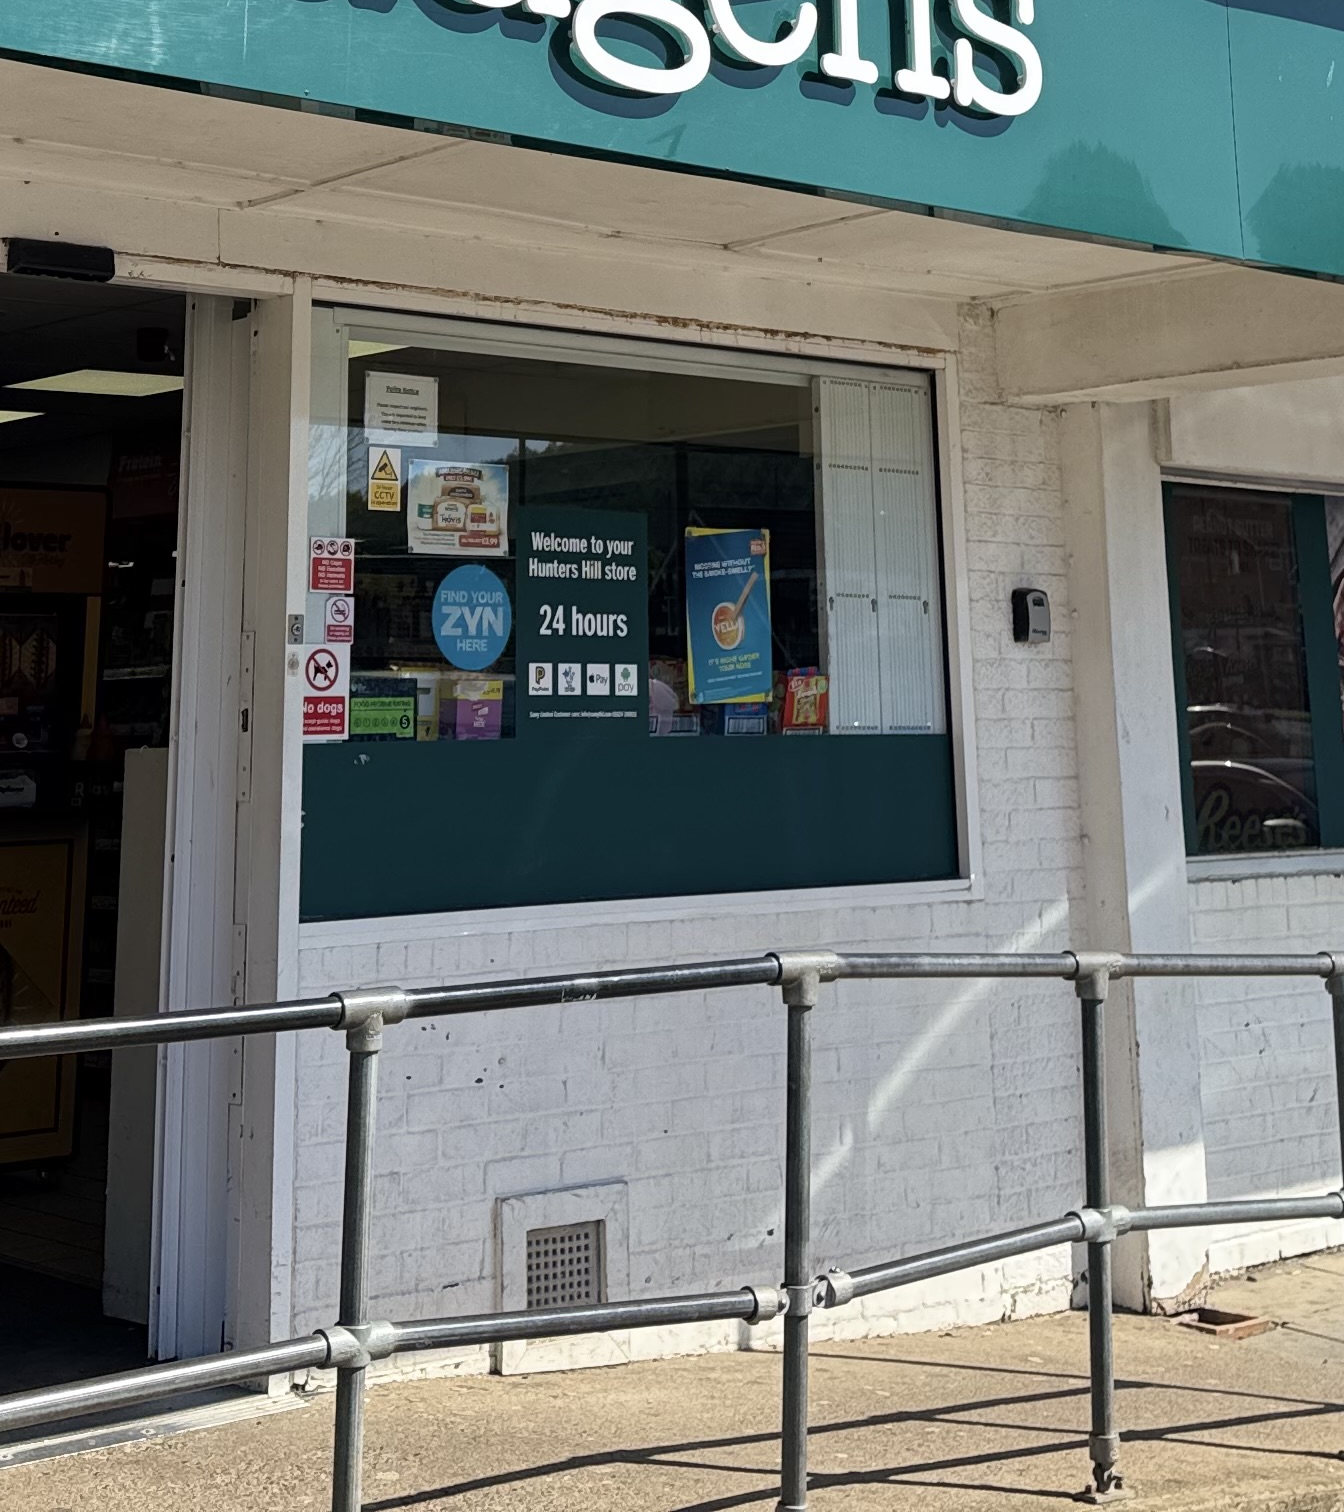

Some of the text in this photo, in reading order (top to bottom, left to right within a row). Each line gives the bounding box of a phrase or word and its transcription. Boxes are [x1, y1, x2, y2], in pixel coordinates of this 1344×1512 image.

[374, 490, 395, 501] CCTV
[531, 532, 634, 558] Welcome to your
[529, 558, 636, 581] Hunters Hill store
[441, 590, 503, 604] FIND YOUR
[440, 605, 504, 636] ZYN
[539, 604, 628, 637] 24 hours
[457, 639, 488, 651] HERE
[596, 674, 608, 686] Pay
[618, 683, 634, 694] pay
[317, 700, 343, 716] dogs
